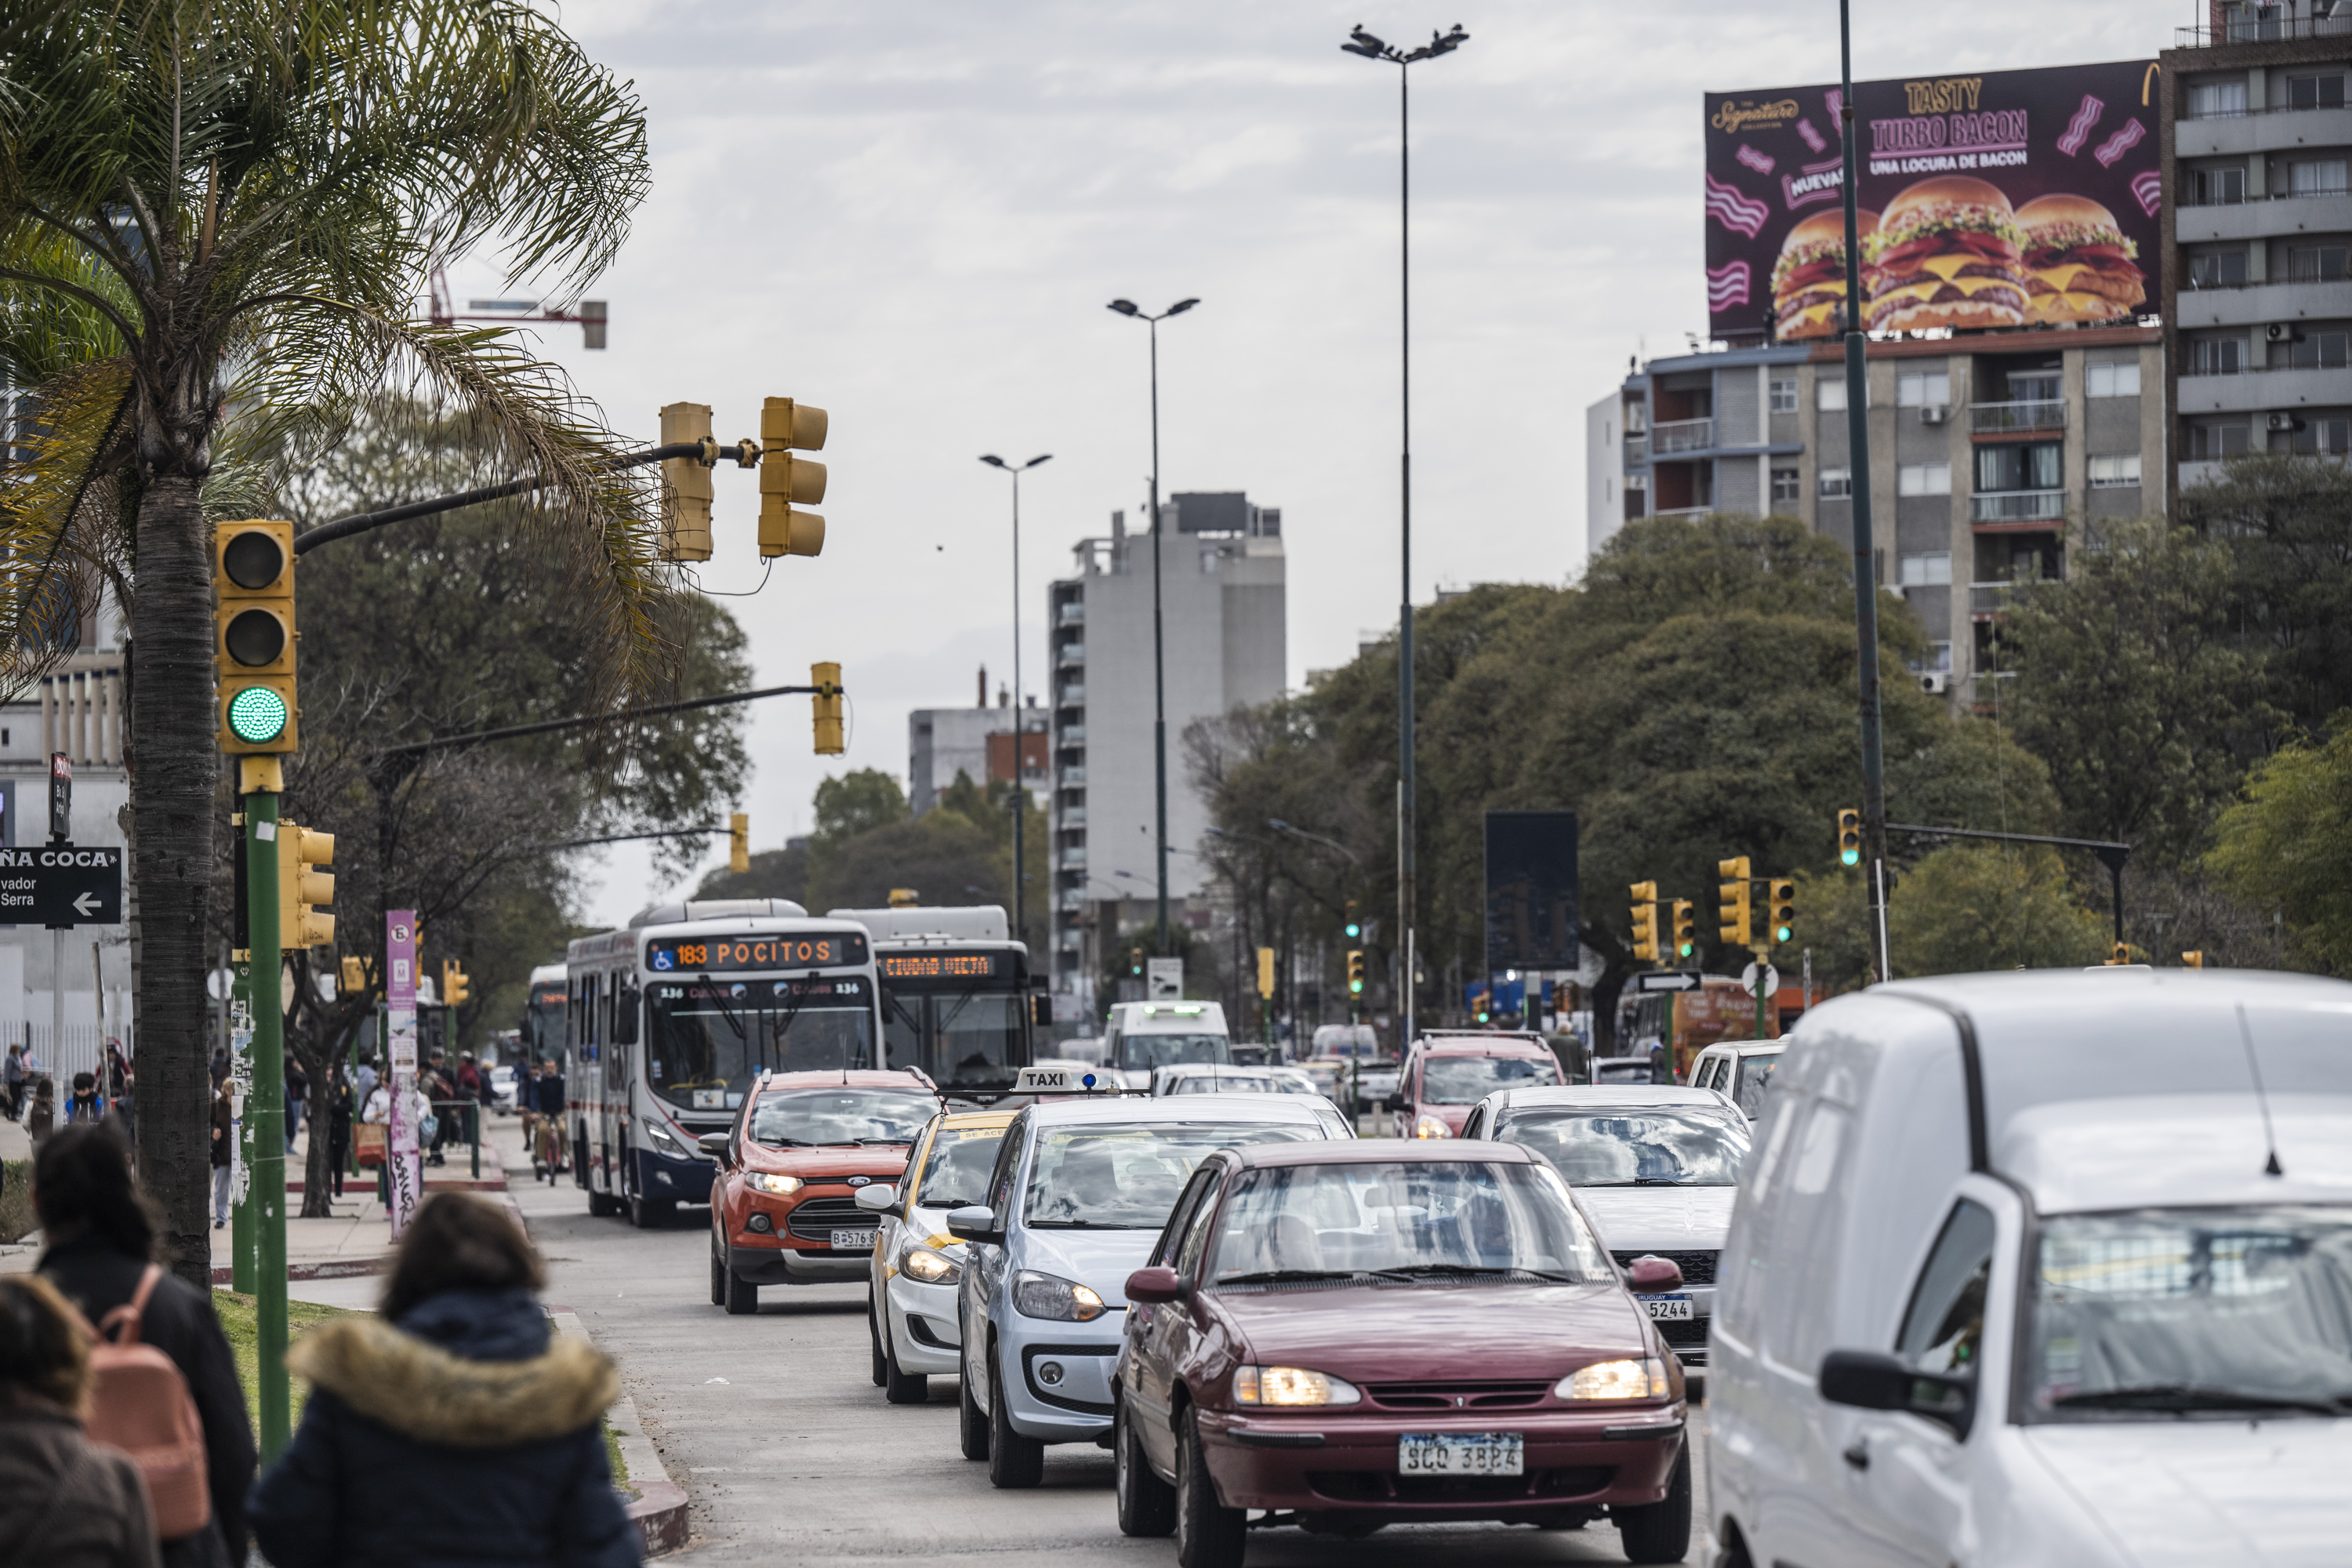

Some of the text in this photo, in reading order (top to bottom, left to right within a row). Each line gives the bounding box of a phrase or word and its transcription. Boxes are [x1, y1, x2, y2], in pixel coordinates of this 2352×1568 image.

[1904, 78, 1981, 114] TASTY
[1711, 99, 1799, 134] Signature
[1870, 109, 2027, 151] TURBO BACON
[1870, 150, 2027, 176] UNA LOCURA DE BACON
[1, 892, 34, 906] Serra
[677, 941, 830, 965] 183 POCITOS
[1026, 1073, 1064, 1087] TAXI
[833, 1232, 840, 1244] B
[1650, 1302, 1687, 1317] 5244
